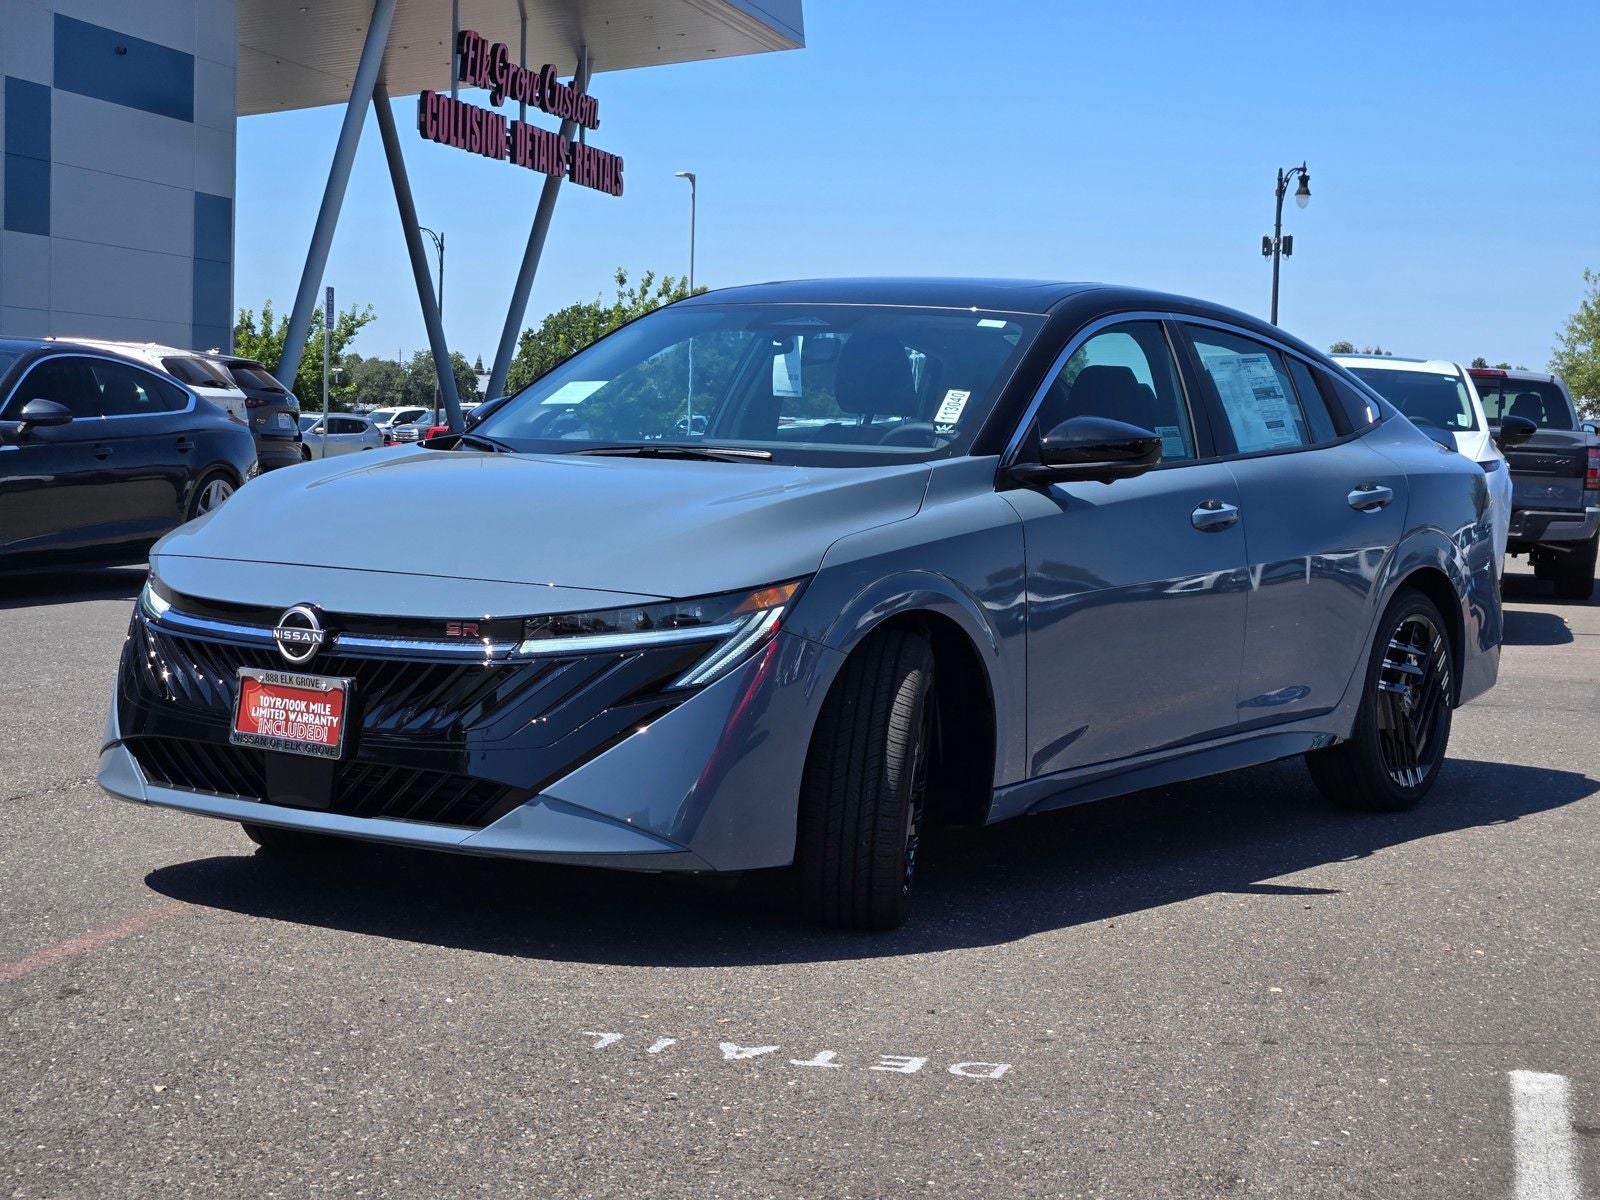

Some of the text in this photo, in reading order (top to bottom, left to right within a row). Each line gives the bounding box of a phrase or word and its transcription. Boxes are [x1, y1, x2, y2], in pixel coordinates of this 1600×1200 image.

[457, 30, 600, 130] Elk Grove Custom
[569, 142, 624, 197] RENTALS
[940, 392, 966, 420] 113040
[272, 629, 323, 643] NISSAN
[446, 622, 479, 637] SR
[265, 672, 320, 689] 888 ELK GROVE
[259, 695, 332, 716] 10YR/100K MILE
[251, 706, 340, 728] LIMITED WARRANTY
[257, 717, 329, 743] INCLUDED!
[233, 734, 337, 757] NISSAN OF ELK GROVE
